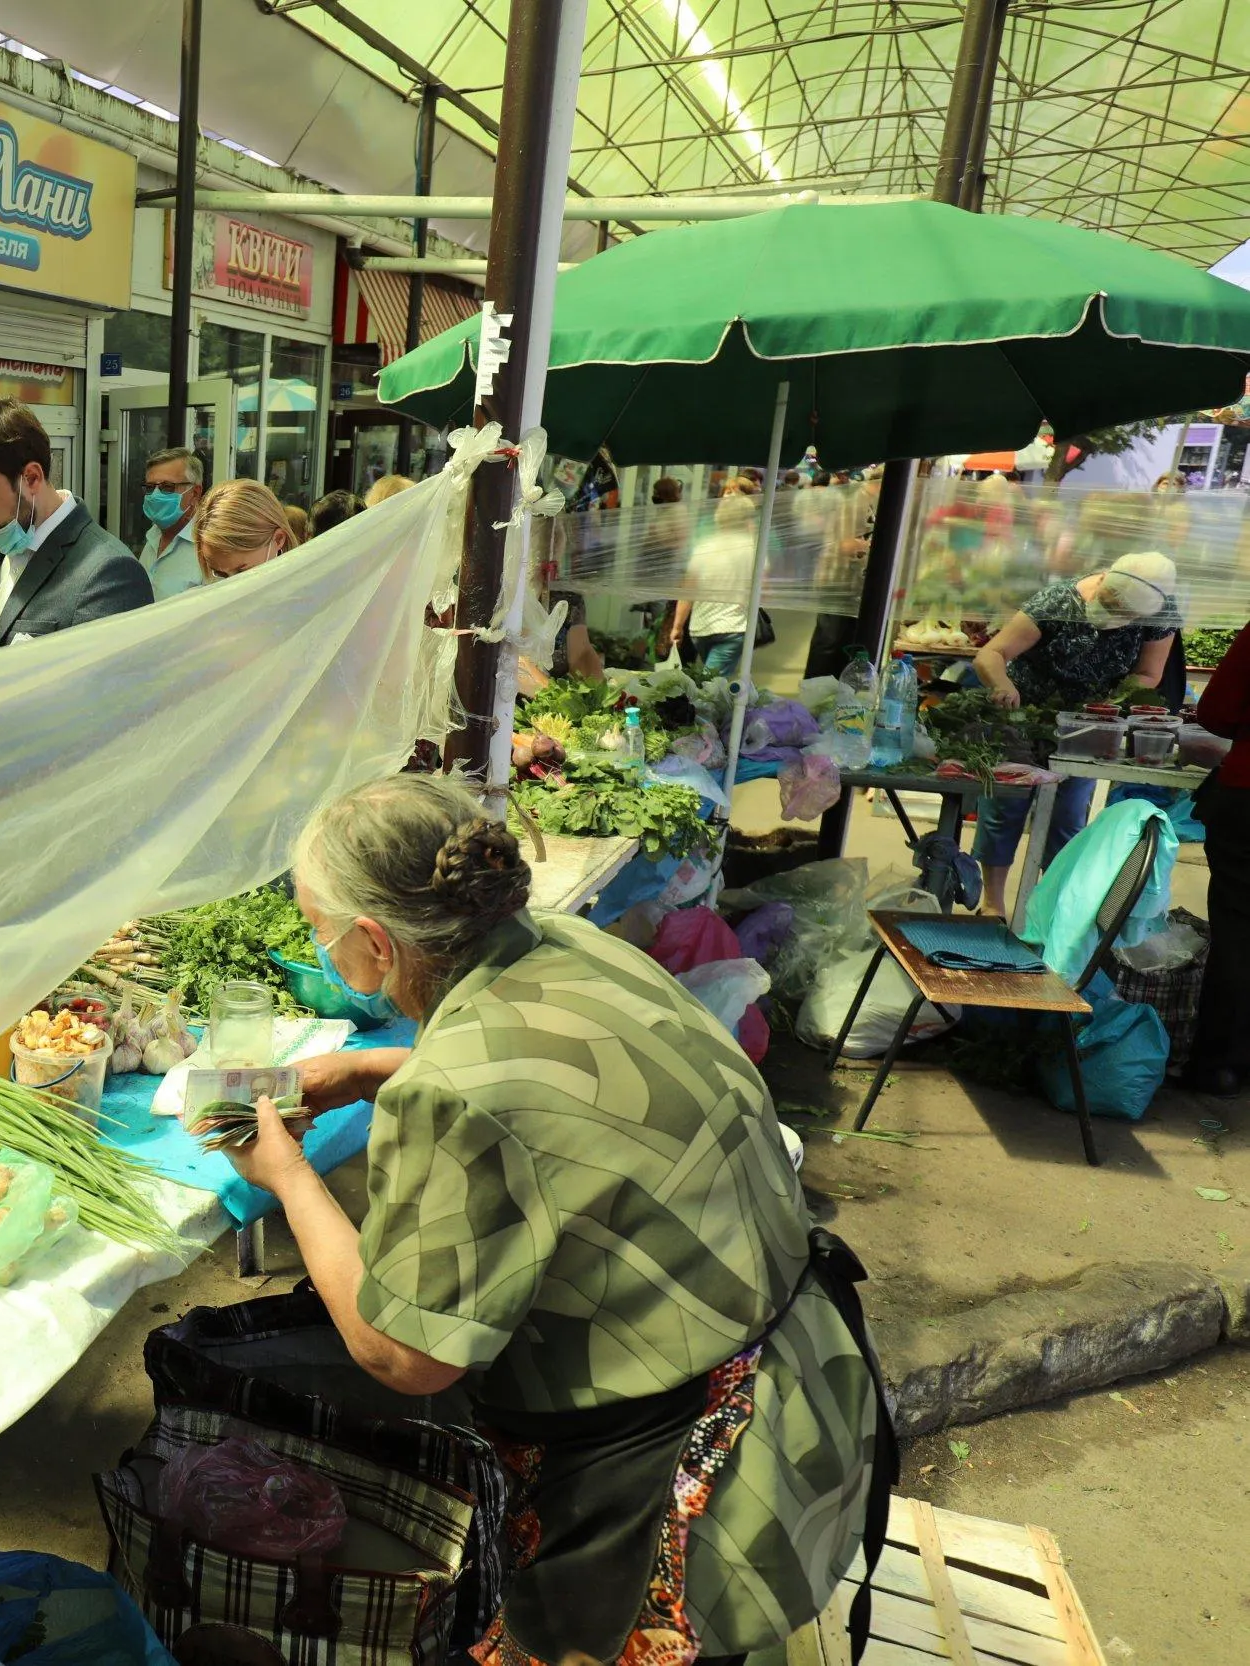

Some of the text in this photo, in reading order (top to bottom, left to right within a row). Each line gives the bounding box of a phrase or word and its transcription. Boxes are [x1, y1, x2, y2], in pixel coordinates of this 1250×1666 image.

[227, 220, 303, 287] КВІТИ
[227, 278, 301, 313] ПОДАРУНКИ
[105, 359, 118, 370] 25
